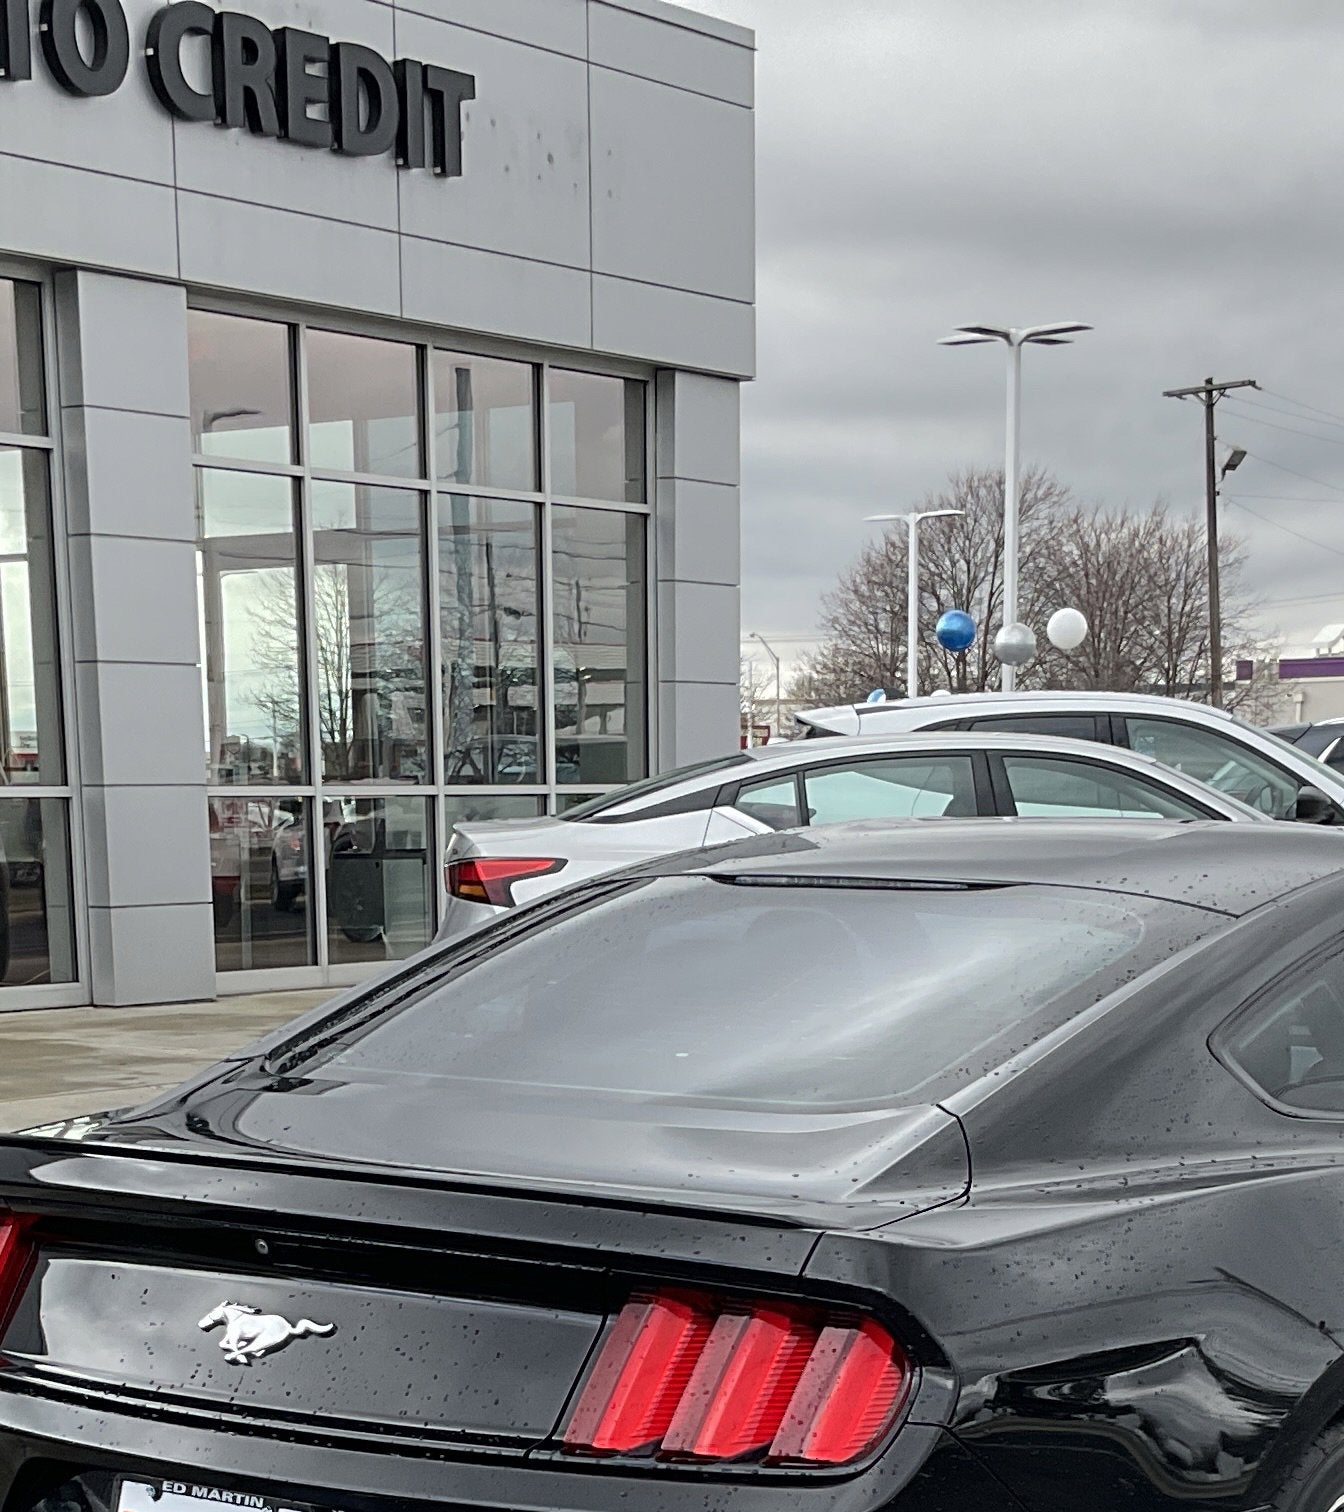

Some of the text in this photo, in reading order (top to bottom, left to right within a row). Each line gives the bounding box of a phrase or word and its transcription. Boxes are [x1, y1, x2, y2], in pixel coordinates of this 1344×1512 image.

[144, 0, 476, 178] CREDIT
[161, 1480, 265, 1509] ED MARTIN
